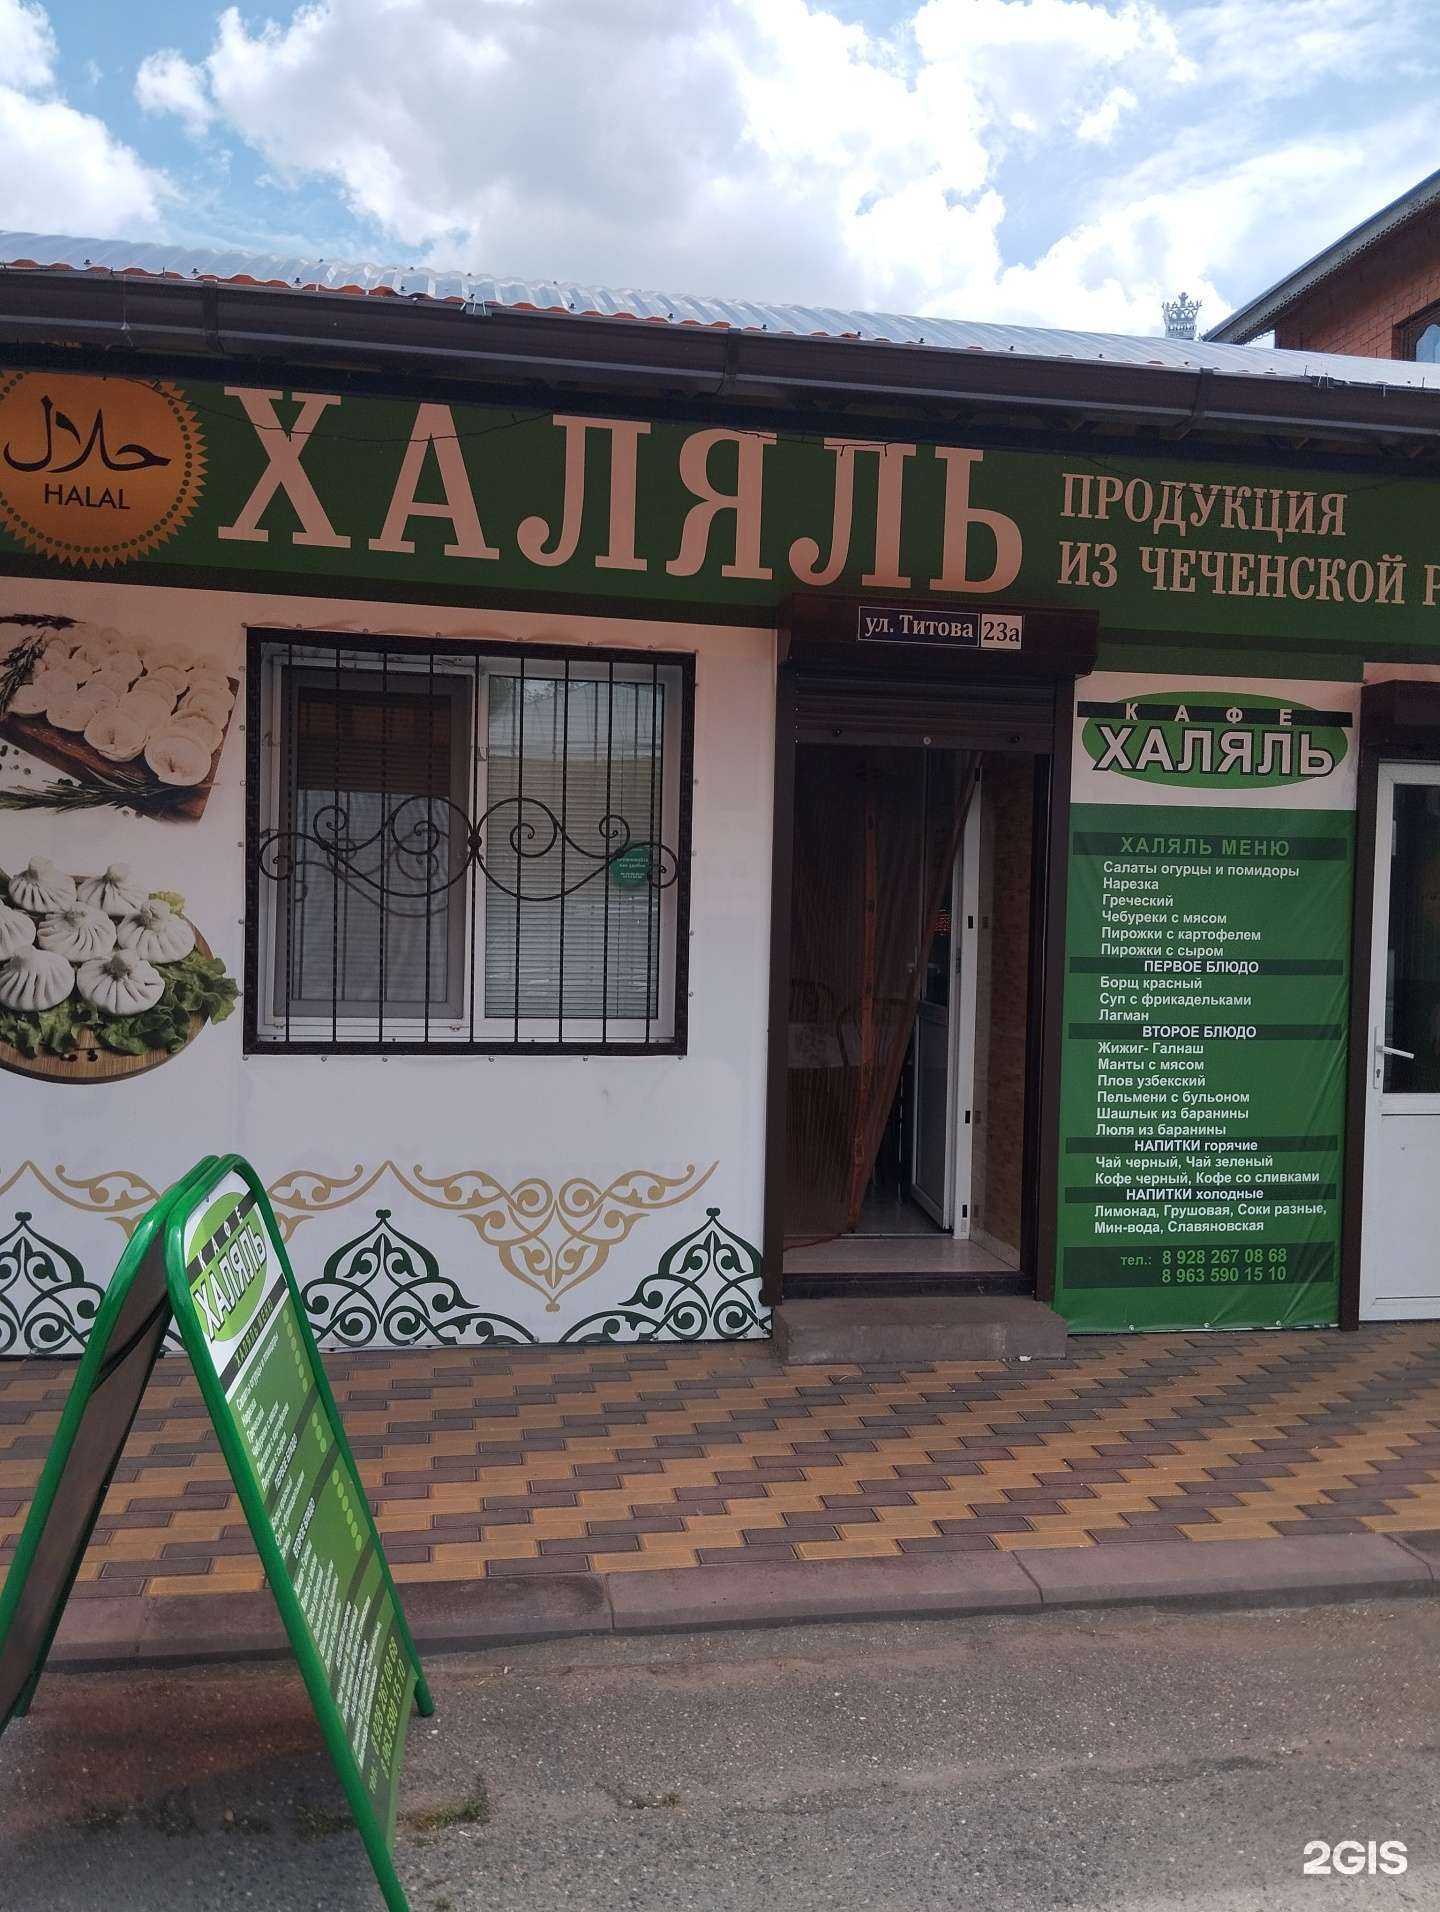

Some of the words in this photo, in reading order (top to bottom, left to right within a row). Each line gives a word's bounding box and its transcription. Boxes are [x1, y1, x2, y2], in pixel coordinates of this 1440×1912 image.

[44, 483, 130, 510] HALAL
[218, 386, 1023, 593] ХАЛЯЛЬ
[1060, 473, 1347, 541] ПРОДУКЦИЯ
[1056, 541, 1117, 588] ИЗ
[1140, 545, 1406, 605] ЧЕЧЕНСКОЙ
[865, 615, 894, 638] ул.
[899, 615, 974, 638] Титова
[983, 621, 1021, 645] 23а
[1093, 724, 1335, 777] ХАЛЯЛЬ
[1120, 836, 1212, 855] ХАЛЯЛЬ
[1222, 840, 1290, 856] МЕНЮ
[1104, 861, 1156, 874] Салаты
[1160, 864, 1211, 877] огурцы
[1216, 866, 1224, 875] и
[1228, 866, 1299, 878] помидоры
[1103, 878, 1158, 891] Нарезка
[1102, 894, 1174, 908] Греческий
[1102, 910, 1167, 924] Чебуреки
[1172, 914, 1178, 923] с
[1183, 914, 1226, 924] мясом
[1102, 927, 1162, 941] Пирожки
[1167, 930, 1174, 939] с
[1178, 929, 1260, 943] картофелем
[1101, 944, 1162, 958] Пирожки
[1166, 947, 1173, 956] с
[1178, 946, 1223, 959] сыром
[1144, 960, 1202, 972] ПЕРВОЕ
[1206, 961, 1259, 974] БЛЮДО
[1100, 976, 1139, 991] Борщ
[1143, 976, 1202, 991] красный
[1100, 993, 1125, 1008] Суп
[1130, 996, 1137, 1004] с
[1142, 994, 1251, 1008] фрикадельками
[1099, 1010, 1149, 1022] Лагман
[1142, 1026, 1199, 1038] ВТОРОЕ
[1204, 1026, 1256, 1039] БЛЮДО
[1098, 1042, 1148, 1054] Жижиг-
[1153, 1042, 1203, 1054] Галнаш
[1098, 1058, 1144, 1070] Манты
[1149, 1061, 1156, 1070] с
[1160, 1060, 1204, 1070] мясом
[1098, 1076, 1132, 1086] Плов
[1137, 1074, 1206, 1090] узбекский
[1098, 1092, 1166, 1104] Пельмени
[1171, 1094, 1178, 1102] с
[1183, 1092, 1250, 1105] бульоном
[1097, 1108, 1157, 1120] Шашлык
[1161, 1110, 1176, 1119] из
[1181, 1107, 1248, 1120] баранины
[1096, 1124, 1134, 1136] Люля
[1138, 1126, 1153, 1135] из
[1158, 1124, 1226, 1137] баранины
[1134, 1140, 1200, 1152] НАПИТКИ
[1204, 1141, 1258, 1152] горячие
[1096, 1156, 1122, 1168] Чай
[1126, 1156, 1182, 1170] черный,
[1186, 1155, 1211, 1168] Чай
[1216, 1156, 1272, 1167] зеленый
[1095, 1172, 1131, 1186] Кофе
[1136, 1172, 1191, 1187] черный,
[1196, 1172, 1231, 1185] Кофе
[1236, 1174, 1251, 1182] со
[1255, 1172, 1319, 1182] сливками
[1126, 1188, 1192, 1200] НАПИТКИ
[1196, 1189, 1263, 1201] холодные
[1095, 1205, 1160, 1220] Лимонад,
[1164, 1204, 1234, 1218] Грушовая,
[1238, 1203, 1270, 1214] Соки
[1274, 1204, 1327, 1217] разные,
[1095, 1222, 1164, 1235] Мин-вода,
[1168, 1220, 1264, 1232] Славяновская
[1120, 1255, 1152, 1266] тел.:
[1162, 1252, 1171, 1264] 8
[1177, 1250, 1205, 1264] 928
[1211, 1250, 1239, 1264] 267
[1244, 1250, 1263, 1263] 08
[1268, 1249, 1286, 1262] 68
[194, 1223, 267, 1339] ХАЛЯЛЬ
[1162, 1269, 1170, 1282] 8
[1177, 1268, 1204, 1282] 963
[1210, 1268, 1238, 1282] 590
[1245, 1267, 1262, 1280] 15
[1268, 1267, 1286, 1280] 10
